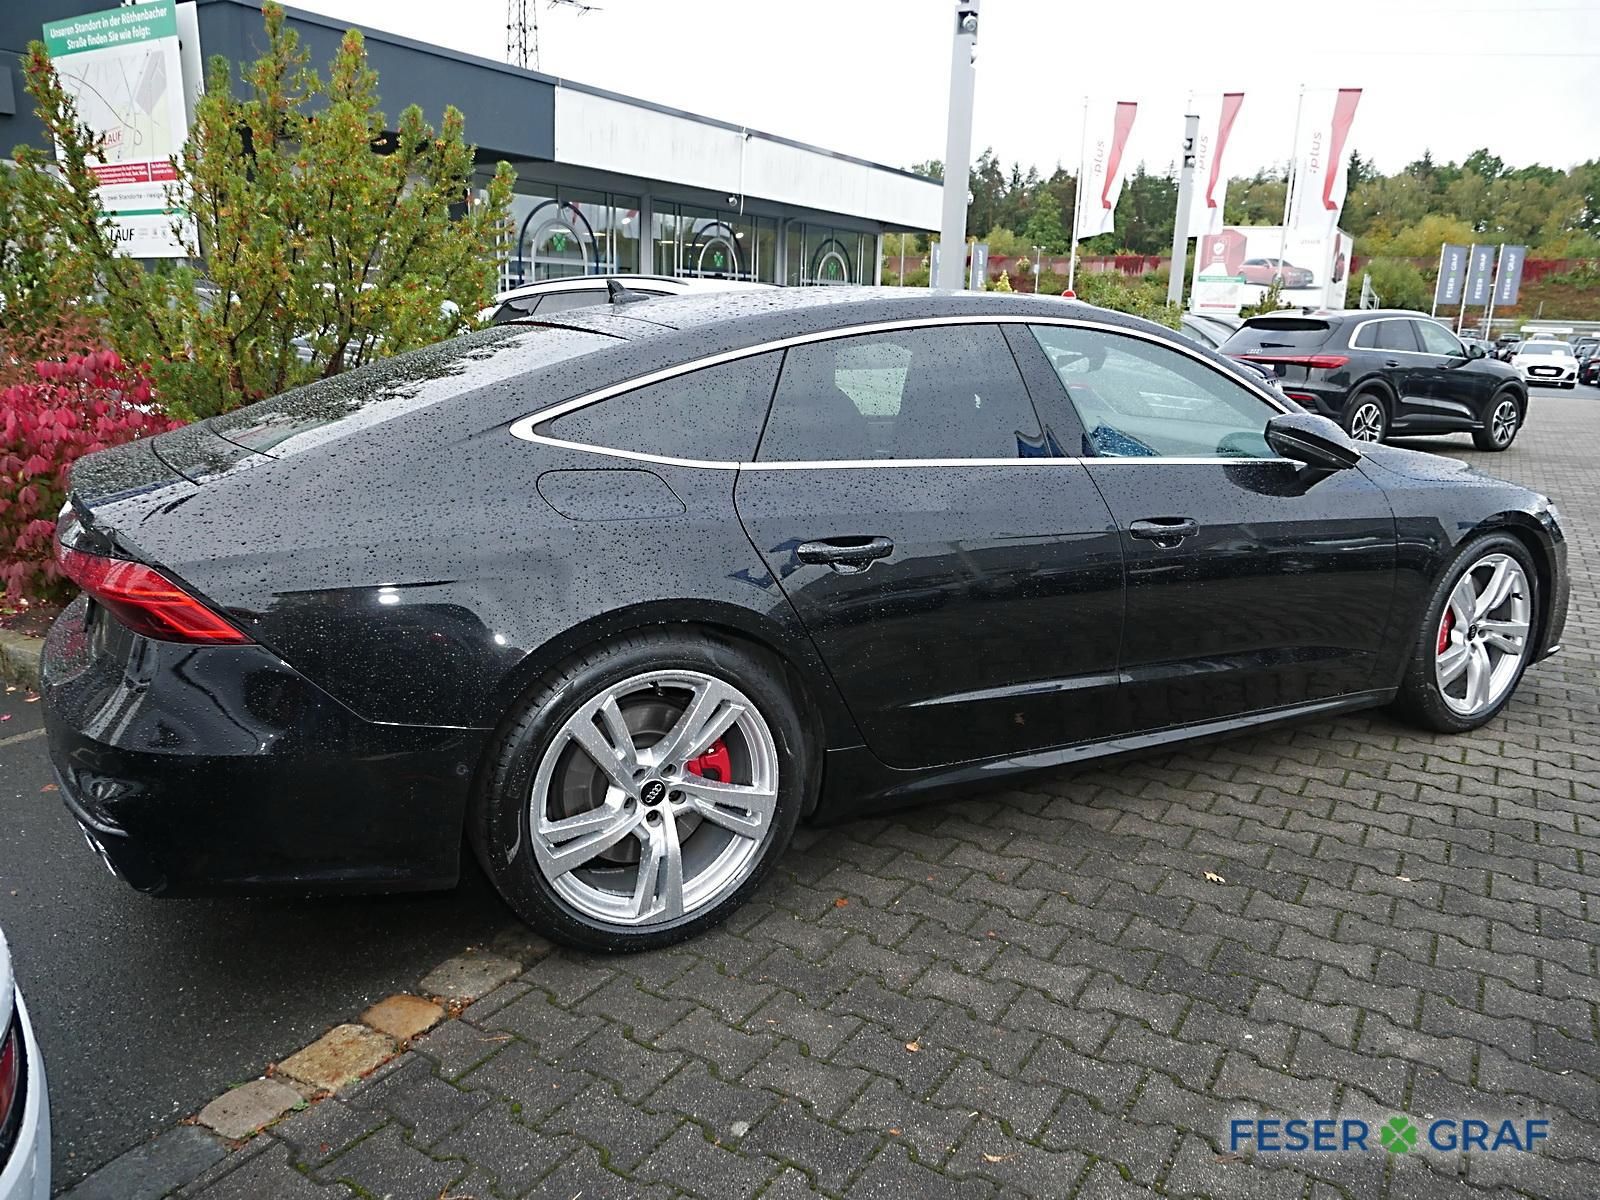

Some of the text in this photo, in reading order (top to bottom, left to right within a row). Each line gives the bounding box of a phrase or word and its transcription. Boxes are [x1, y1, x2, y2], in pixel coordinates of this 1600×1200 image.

[50, 7, 167, 39] Unseren Standort in der Röthenbacher
[67, 26, 151, 50] Straße finden Sie wie folgt:
[110, 228, 135, 241] LAUF
